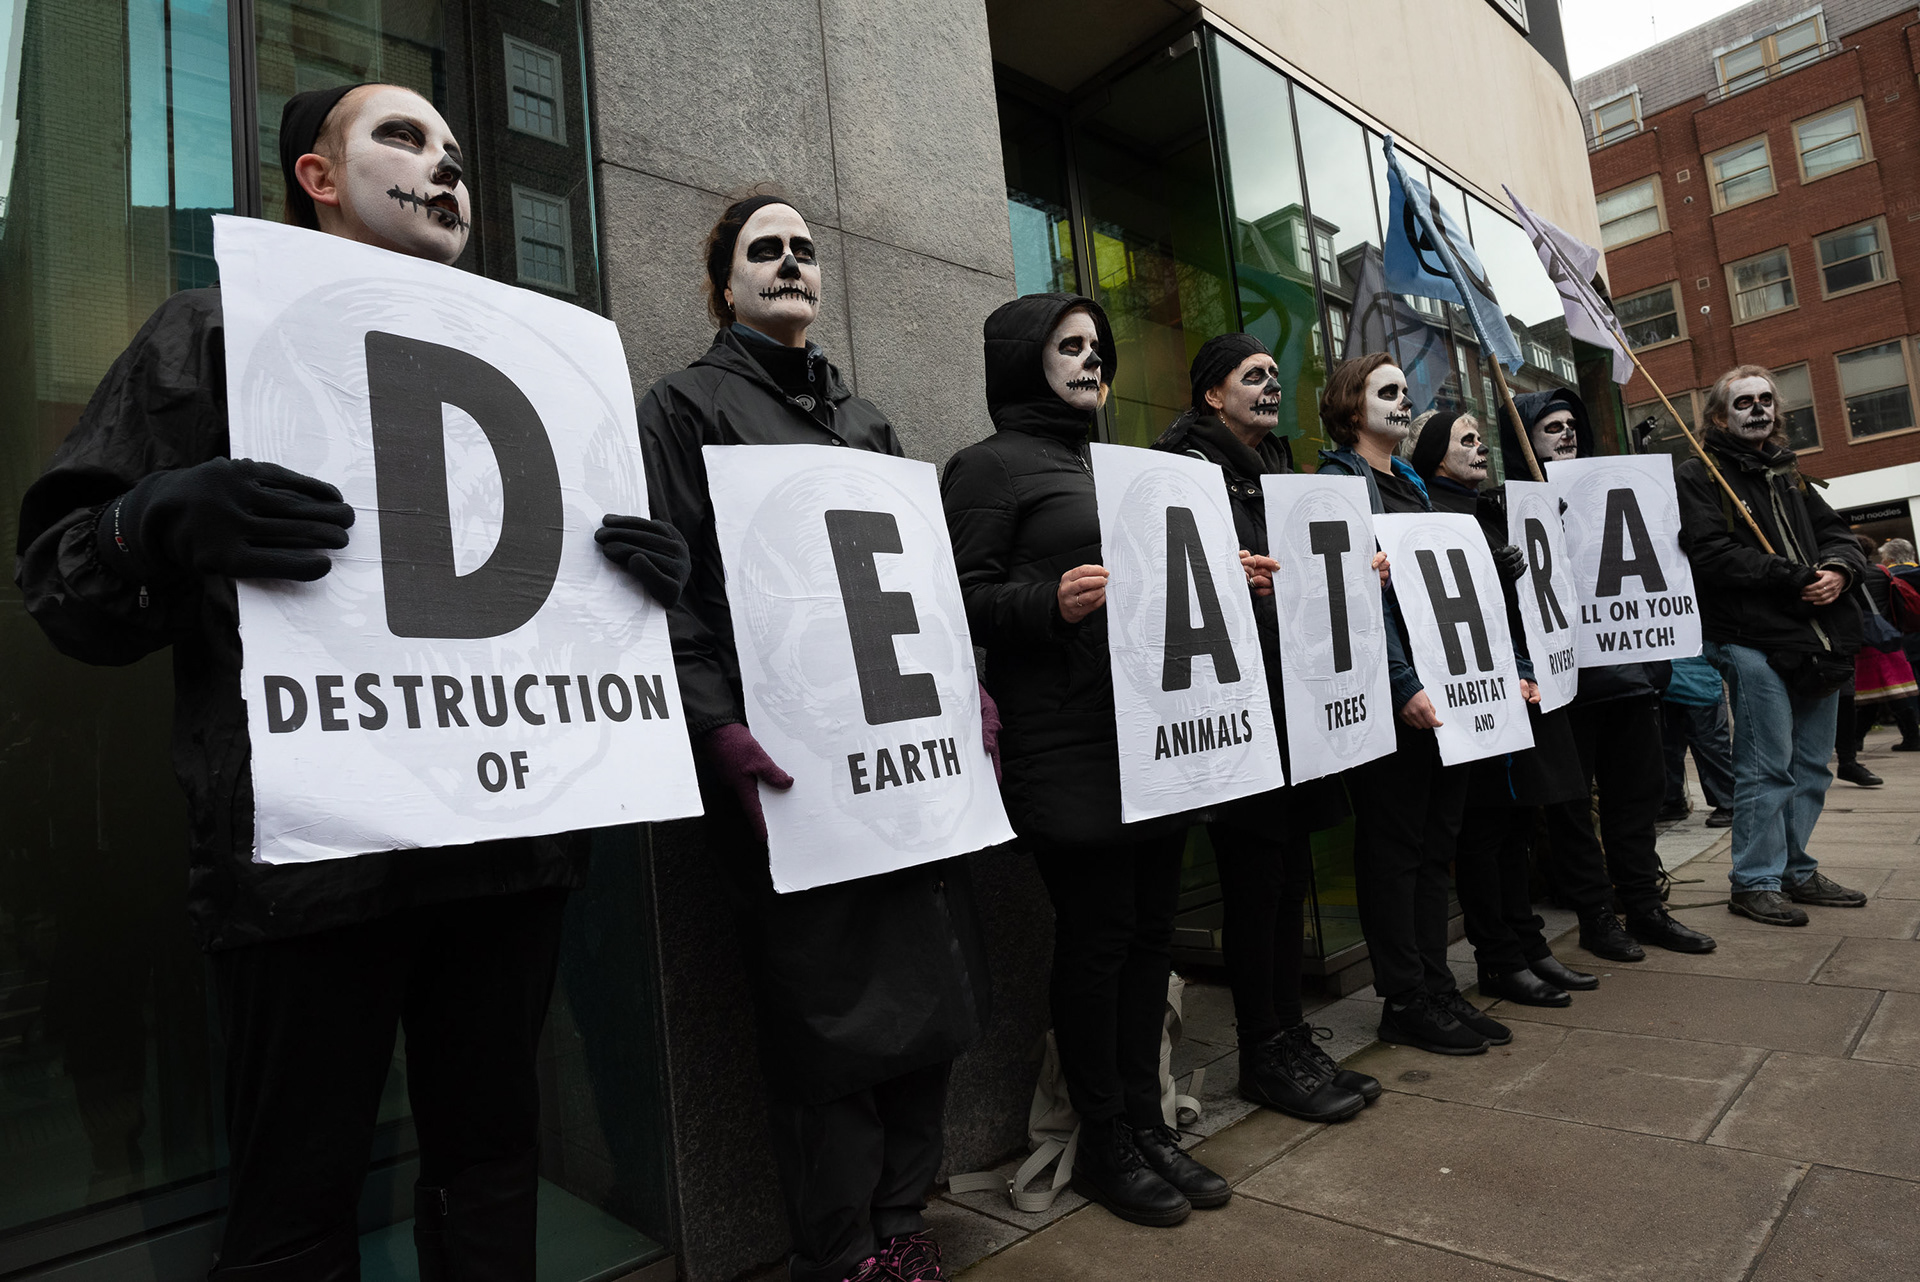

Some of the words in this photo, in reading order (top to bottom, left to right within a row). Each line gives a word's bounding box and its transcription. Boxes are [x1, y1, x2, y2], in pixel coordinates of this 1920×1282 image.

[365, 330, 564, 640] D
[1850, 513, 1865, 521] hot
[1866, 508, 1901, 519] noodles
[1594, 487, 1668, 598] A
[1161, 506, 1241, 692] A
[1308, 520, 1353, 674] T
[1524, 517, 1569, 634] R
[825, 509, 943, 726] E
[1415, 548, 1495, 676] H
[1581, 604, 1602, 625] LL
[1609, 600, 1640, 622] ON
[1645, 595, 1695, 618] YOUR
[1548, 646, 1575, 676] RIVERS
[1595, 626, 1676, 653] WATCH!
[263, 672, 670, 734] DESTRUCTION
[1324, 693, 1367, 732] TREES
[1444, 676, 1507, 709] HABITAT
[1154, 709, 1253, 761] ANIMALS
[1474, 713, 1495, 733] AND
[476, 750, 530, 793] OF
[847, 737, 962, 795] EARTH
